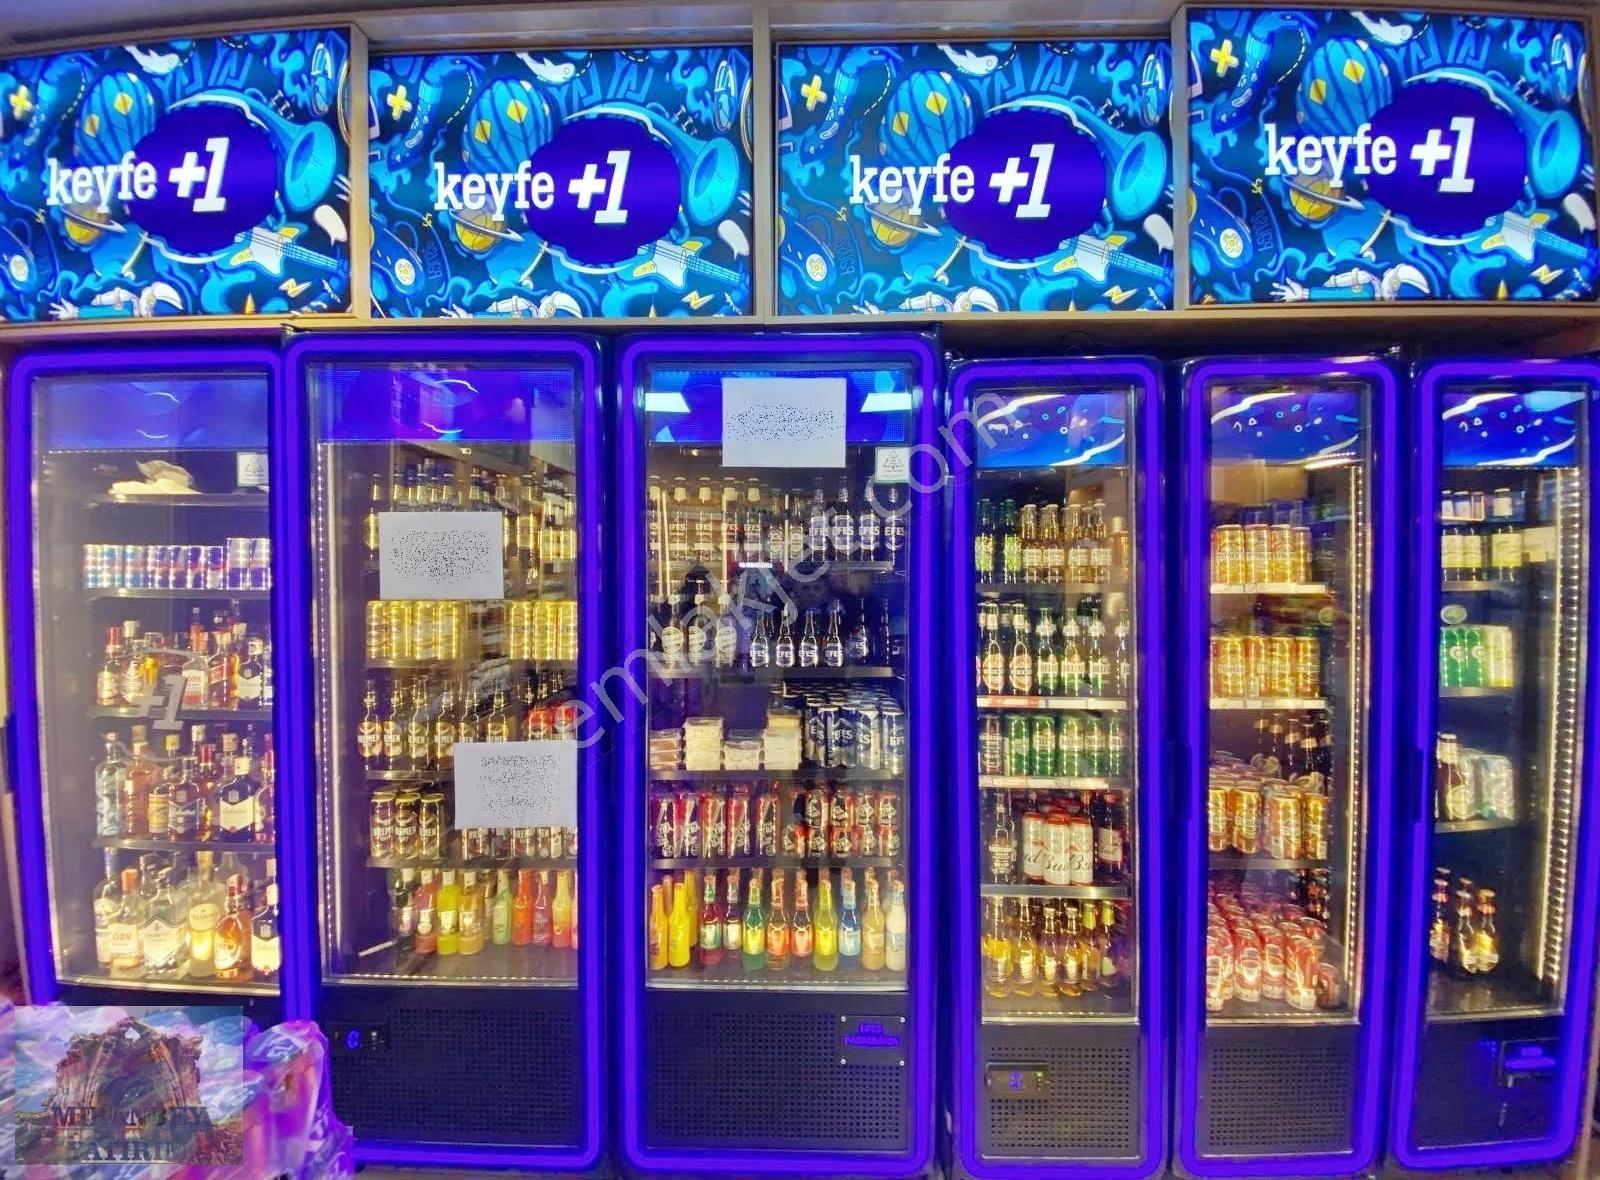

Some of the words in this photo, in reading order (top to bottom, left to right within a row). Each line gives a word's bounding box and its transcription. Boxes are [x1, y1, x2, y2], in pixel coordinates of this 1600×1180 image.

[45, 150, 157, 216] keyfe
[167, 136, 230, 213] +1
[433, 159, 555, 222] keyfe
[567, 149, 632, 224] +1
[848, 152, 976, 217] keyfe
[988, 142, 1056, 219] +1
[1264, 122, 1398, 189] keyfe
[1409, 116, 1475, 194] +1
[832, 526, 855, 537] EFES
